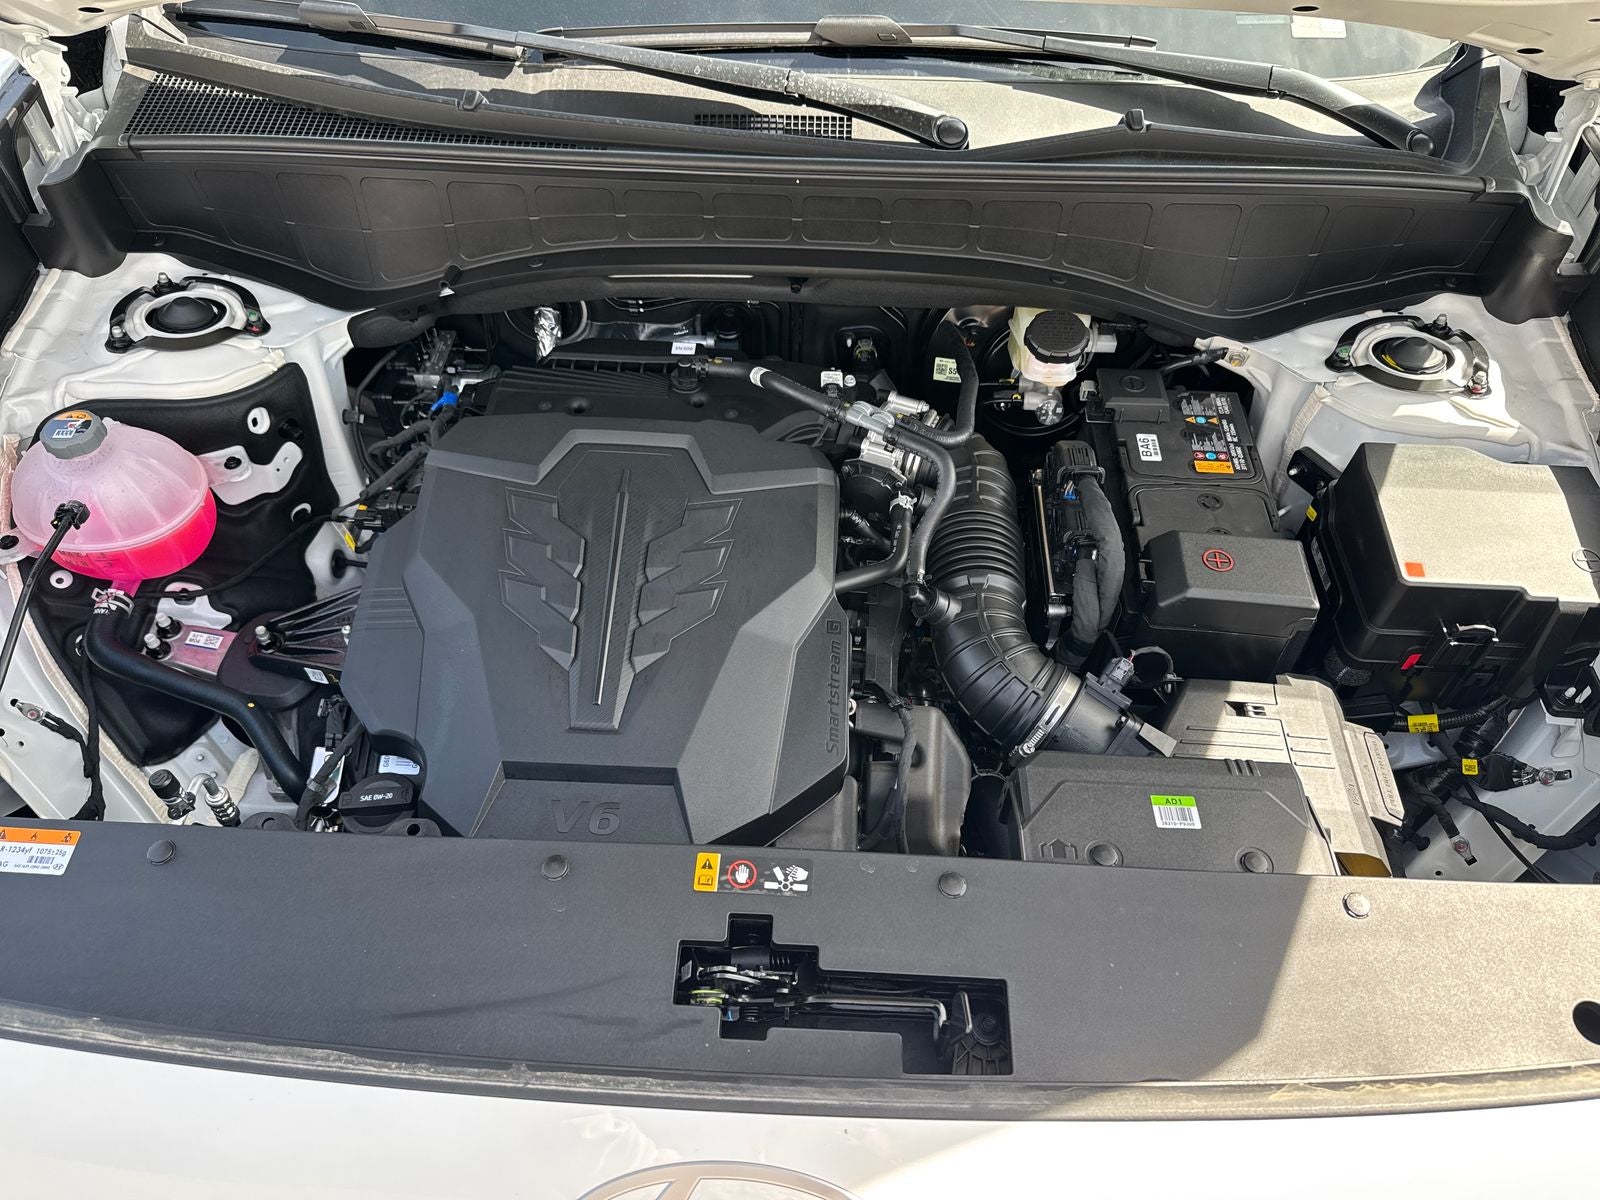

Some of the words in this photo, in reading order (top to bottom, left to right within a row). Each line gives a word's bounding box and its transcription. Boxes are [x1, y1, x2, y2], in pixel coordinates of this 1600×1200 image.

[1138, 437, 1153, 458] BA6
[825, 640, 841, 756] Smartstream
[373, 792, 394, 801] 0W-20
[550, 799, 621, 836] V6
